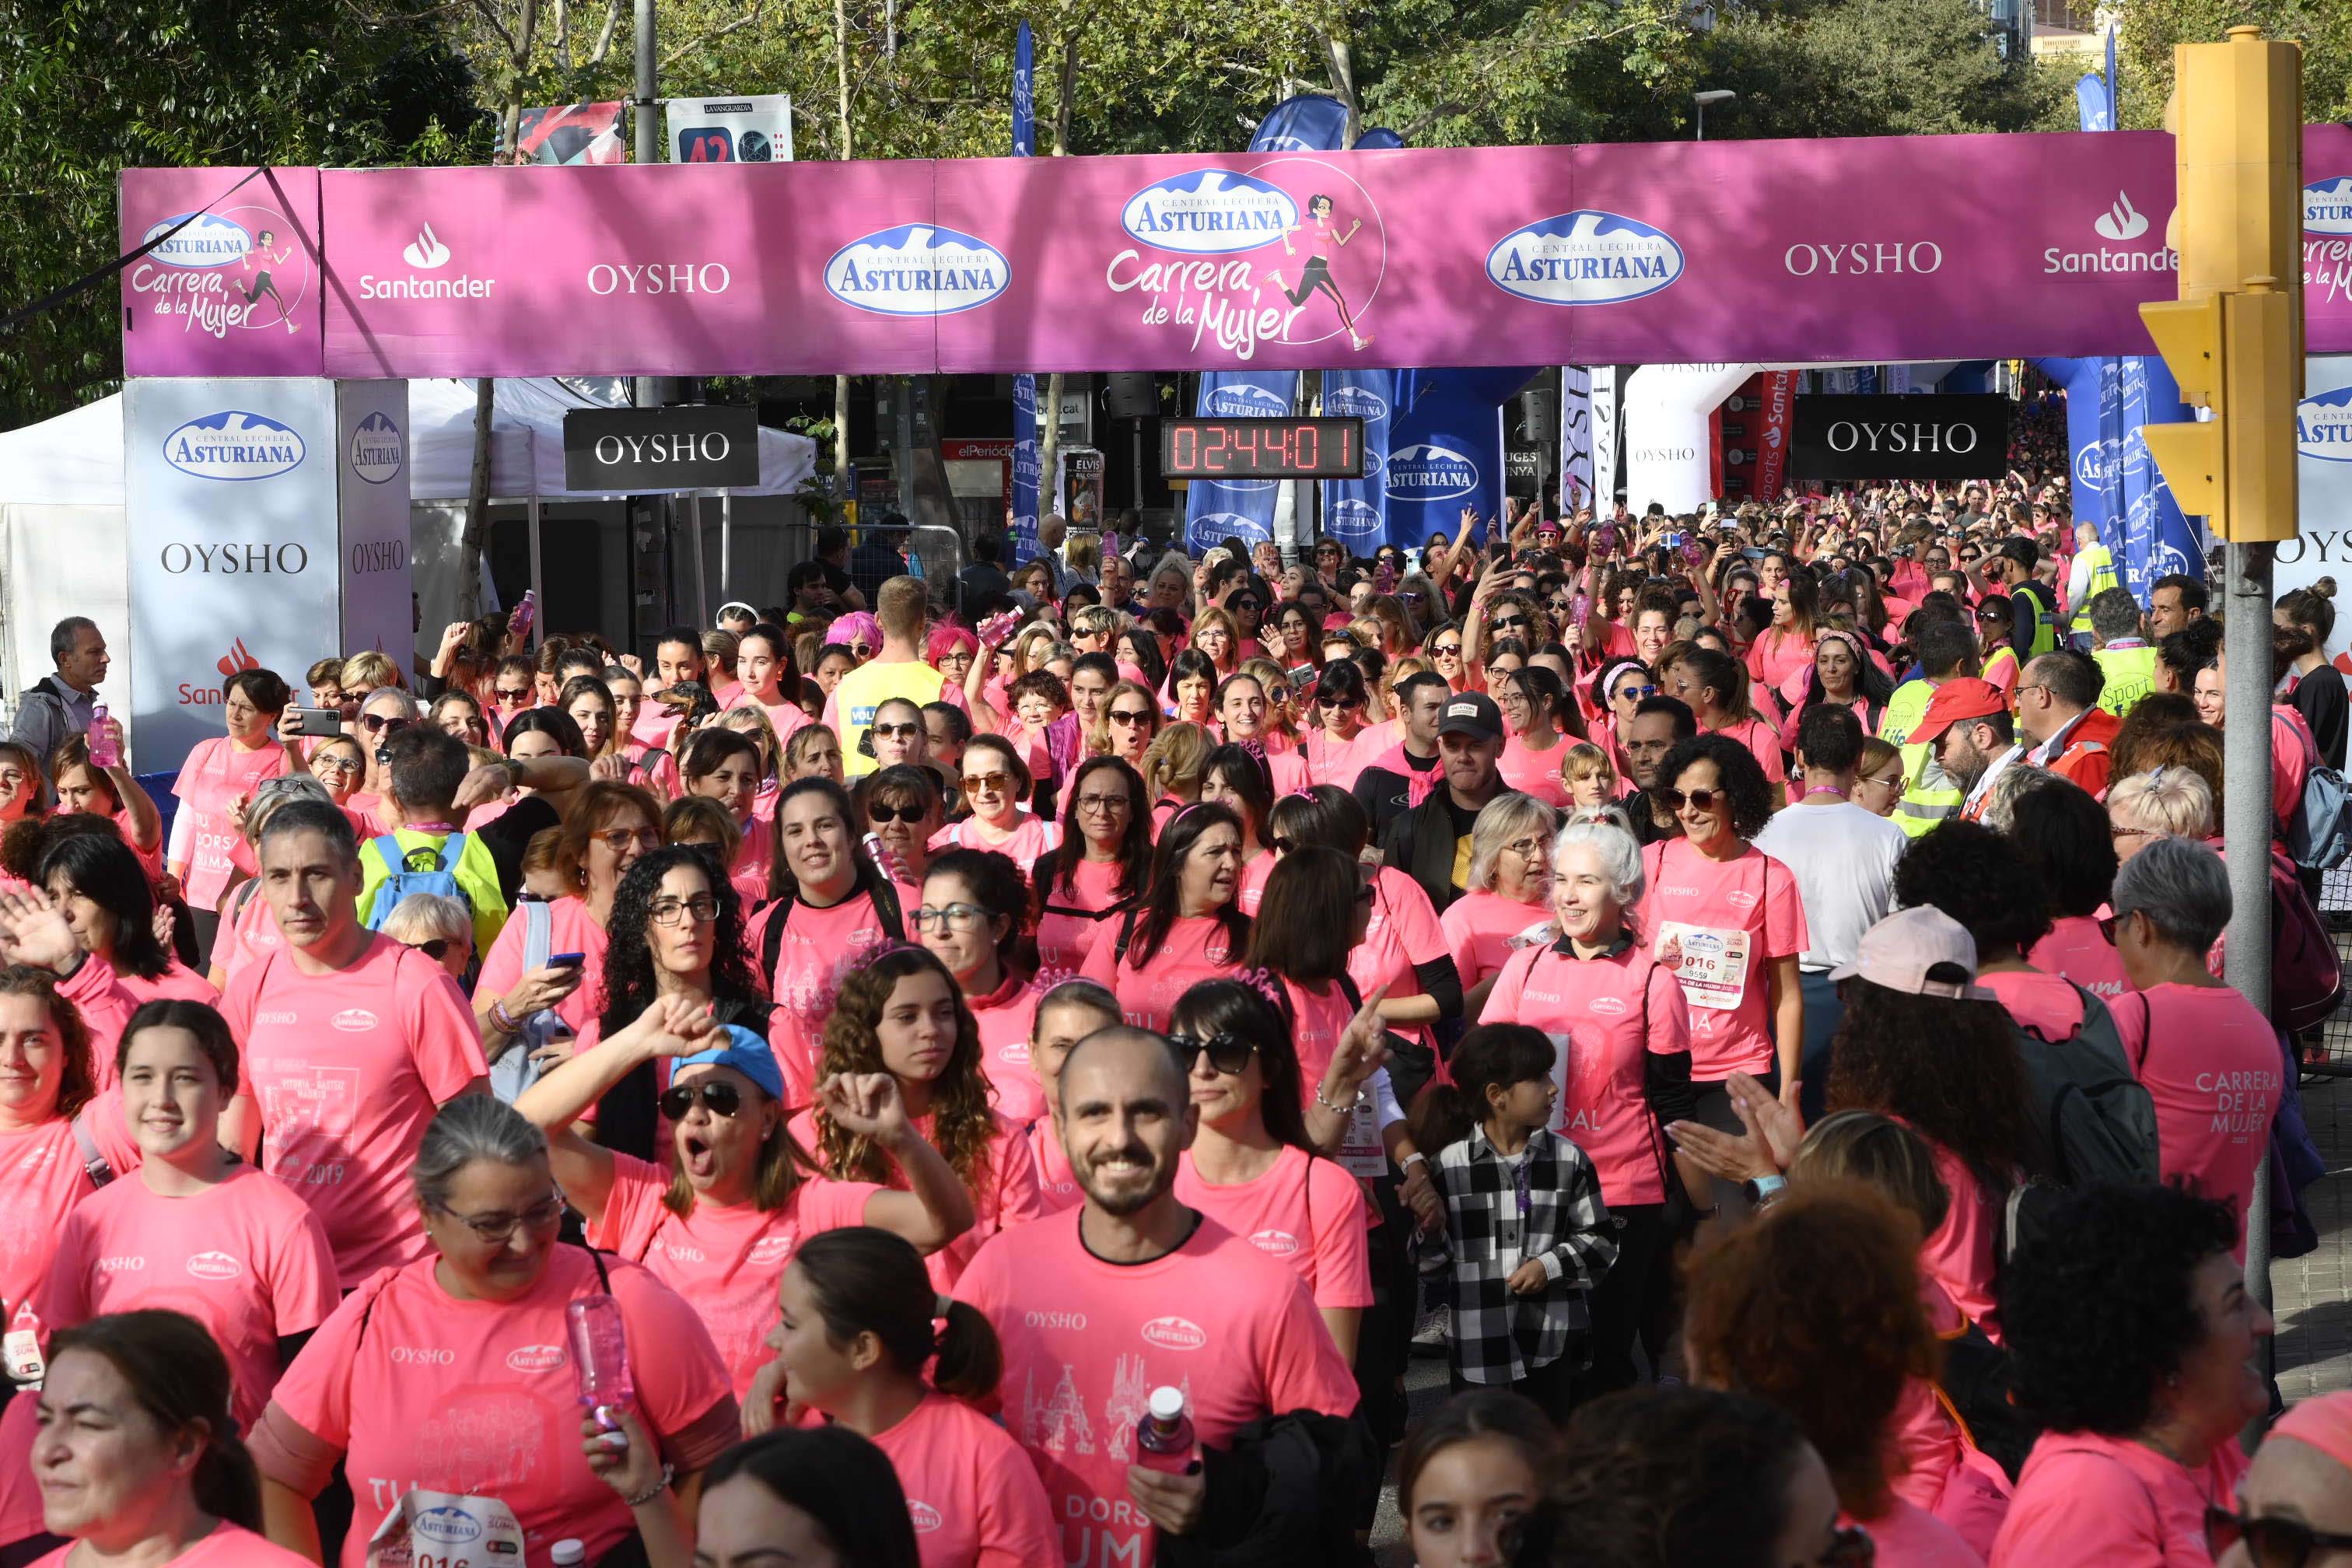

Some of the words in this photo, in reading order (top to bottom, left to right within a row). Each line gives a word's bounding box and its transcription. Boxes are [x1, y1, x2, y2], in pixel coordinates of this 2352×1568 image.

[712, 103, 751, 113] VANGUARDIA
[1164, 198, 1219, 207] CENTRAL
[1222, 197, 1279, 206] LECHERA
[1135, 201, 1283, 233] ASTURIANA
[1532, 245, 1592, 254] CENTRAL
[1599, 243, 1662, 251] LECHERA
[1785, 241, 1942, 275] OYSHO
[867, 256, 926, 264] CENTRAL
[932, 255, 989, 264] LECHERA
[1501, 247, 1669, 281] ASTURIANA
[2044, 247, 2179, 273] Santande
[131, 264, 223, 293] Carrera
[587, 263, 730, 295] OYSHO
[838, 259, 997, 291] ASTURIANA
[1106, 249, 1252, 292] Carrera
[359, 275, 495, 299] Santander
[154, 294, 171, 314] de
[175, 295, 187, 314] la
[184, 291, 257, 338] Mujer
[1142, 294, 1169, 325] de
[1175, 292, 1195, 324] la
[1191, 286, 1307, 361] Mujer
[1211, 396, 1284, 418] ASTURIANA
[245, 434, 291, 443] LECHERA
[1174, 426, 1347, 469] 02:44:01
[1827, 422, 1977, 453] OYSHO
[174, 437, 296, 464] ASTURIANA
[354, 437, 400, 467] ASTURIANA
[596, 432, 730, 465] OYSHO
[958, 445, 1014, 458] elPeriódi
[1636, 447, 1695, 462] OYSHO
[1076, 460, 1101, 470] ELVIS
[1384, 467, 1472, 488] ASTURIANA
[161, 543, 309, 575] OYSHO
[352, 540, 404, 575] OYSHO
[2103, 677, 2151, 707] Sport
[197, 833, 240, 850] DORS
[195, 852, 235, 870] SUMA
[1664, 887, 1699, 897] OYSHO
[1686, 938, 1720, 950] ASTURIANA
[1685, 956, 1716, 971] 016
[1689, 970, 1708, 980] 9559
[1523, 990, 1561, 1004] OYSHO
[256, 1012, 298, 1025] OYSHO
[282, 1080, 310, 1090] VITORIA
[2195, 1070, 2279, 1094] CARRERA
[2218, 1094, 2244, 1112] DE
[2249, 1094, 2266, 1111] LA
[2210, 1114, 2265, 1133] MUJER
[307, 1164, 345, 1185] 2019
[1025, 1311, 1087, 1331] OYSHO
[390, 1346, 455, 1366] OYSHO
[1066, 1493, 1152, 1528] DORS
[419, 1518, 476, 1537] ASTURIANA
